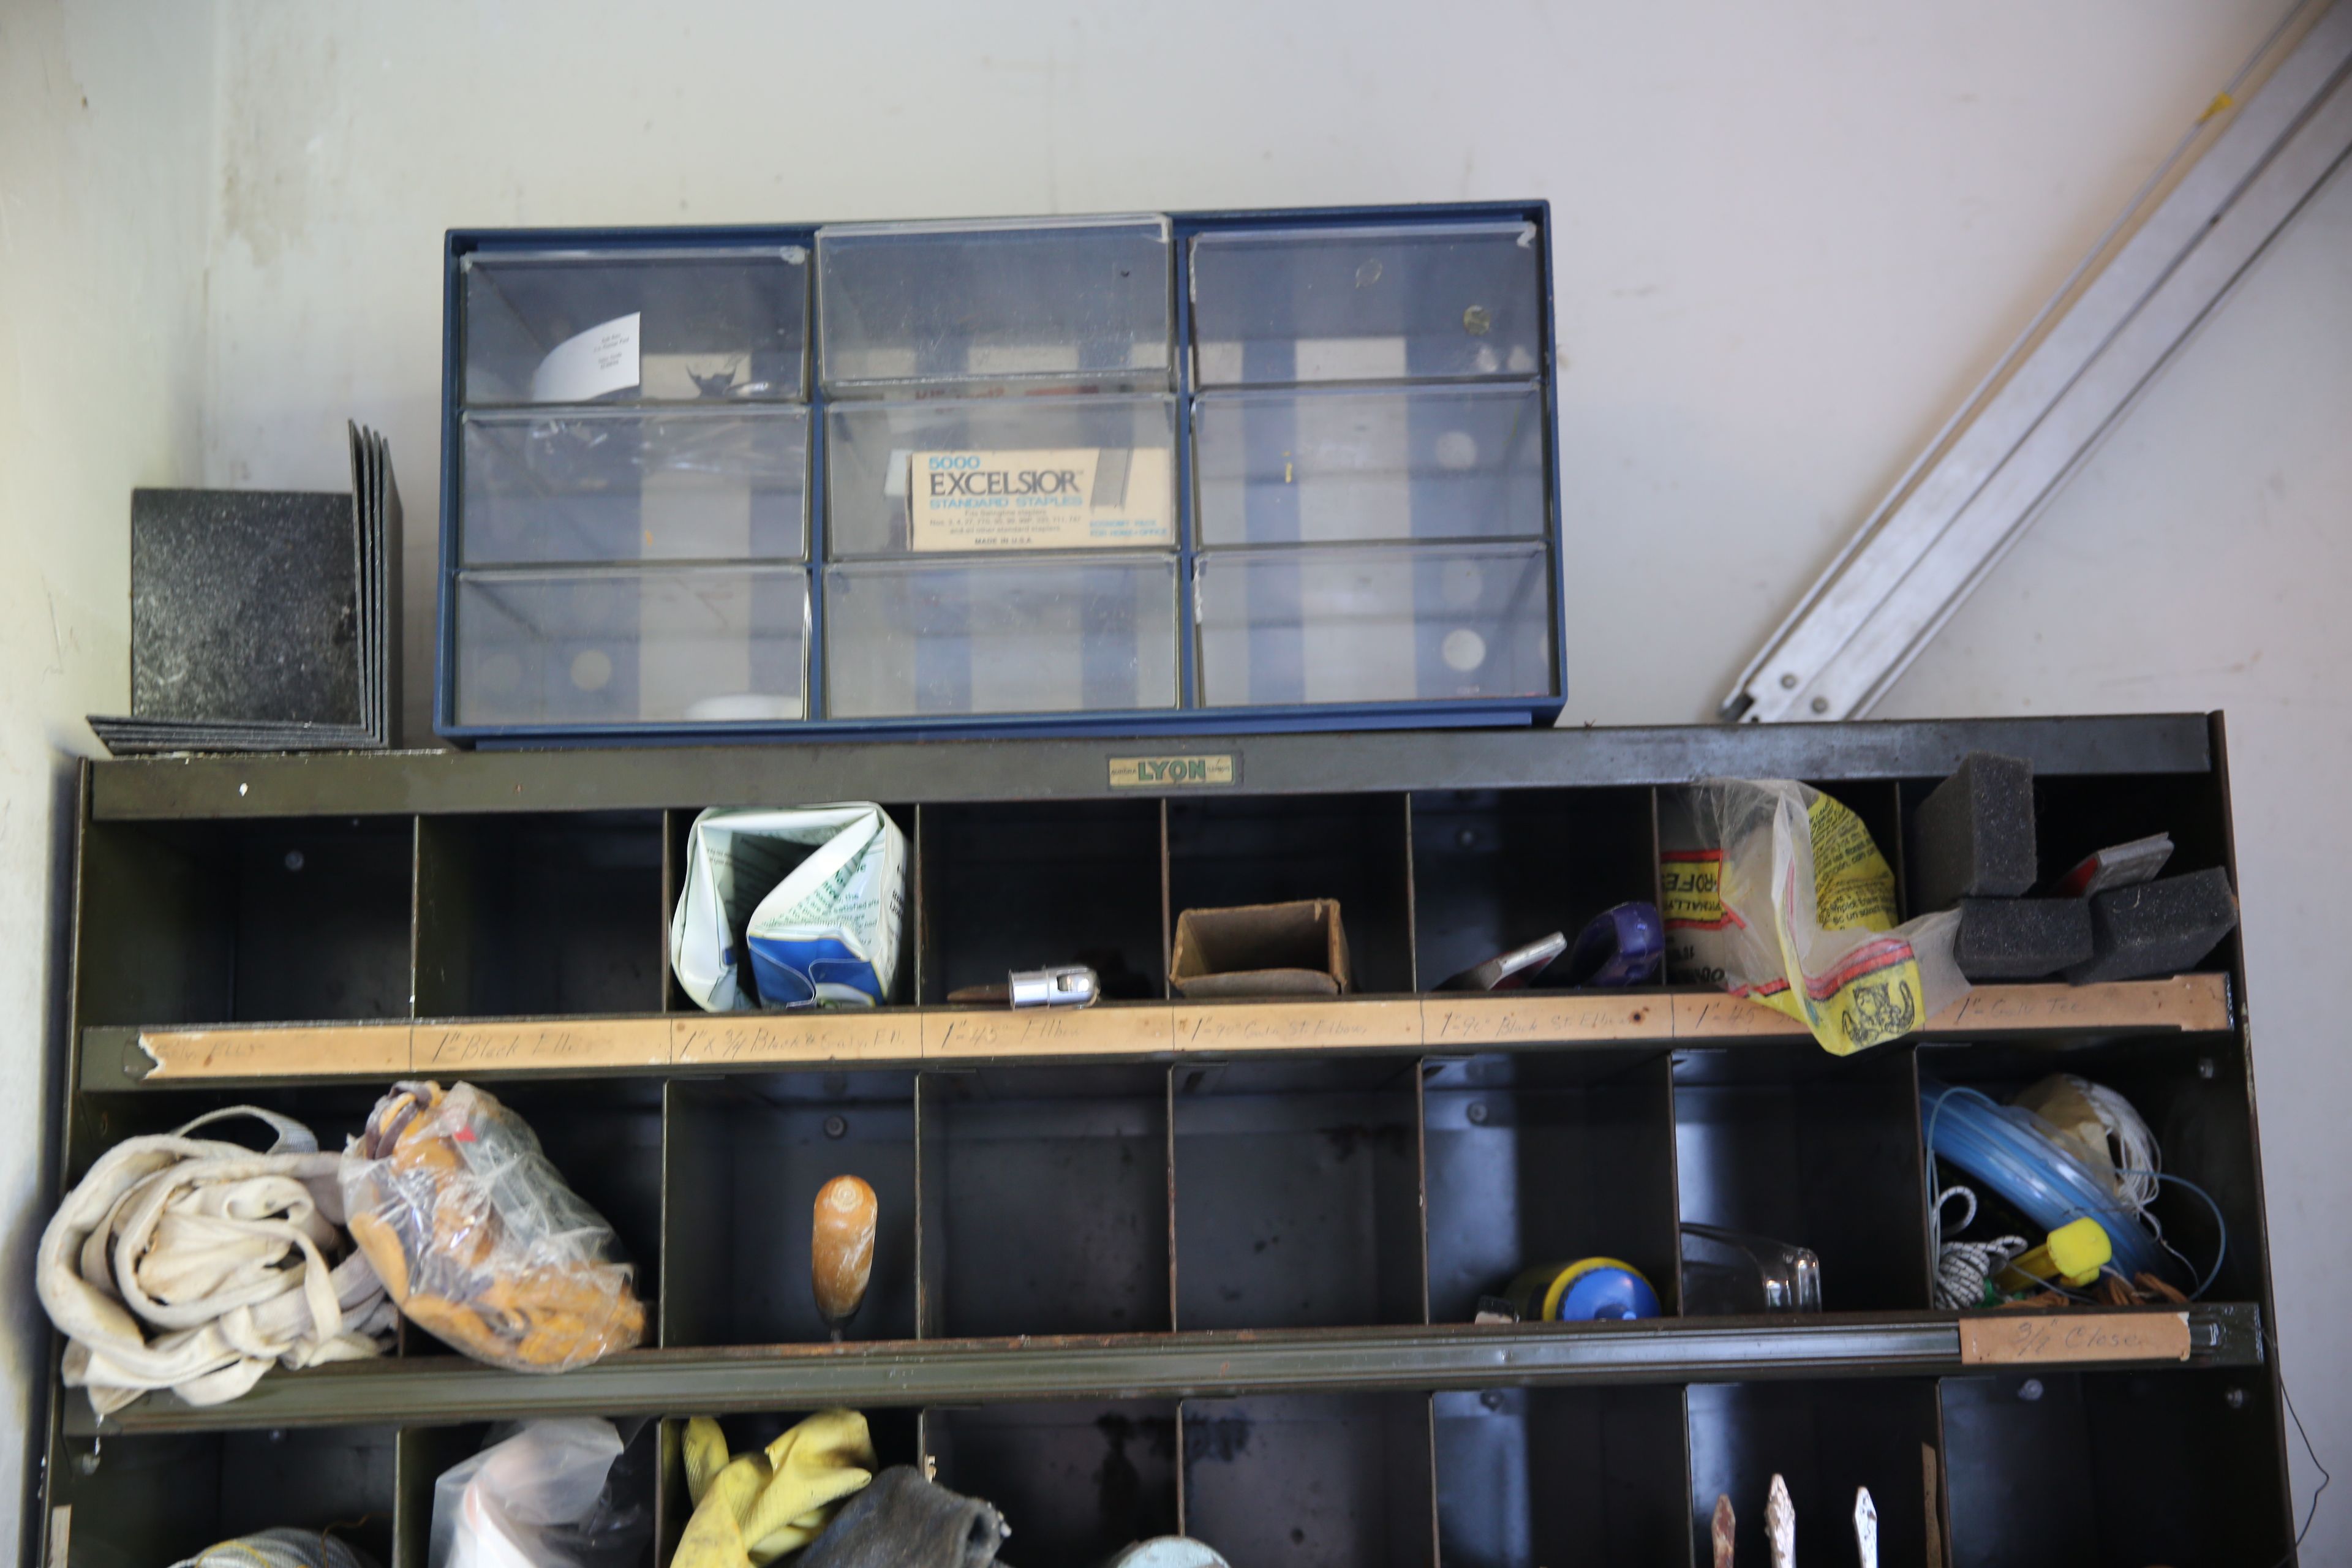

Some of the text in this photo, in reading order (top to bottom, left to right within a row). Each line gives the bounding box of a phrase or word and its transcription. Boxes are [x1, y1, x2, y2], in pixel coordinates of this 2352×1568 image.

[929, 456, 981, 470] 5000
[930, 470, 1082, 497] EXCELSIOR
[930, 496, 1083, 510] STANDARD STAPLES
[1138, 758, 1206, 782] LYON
